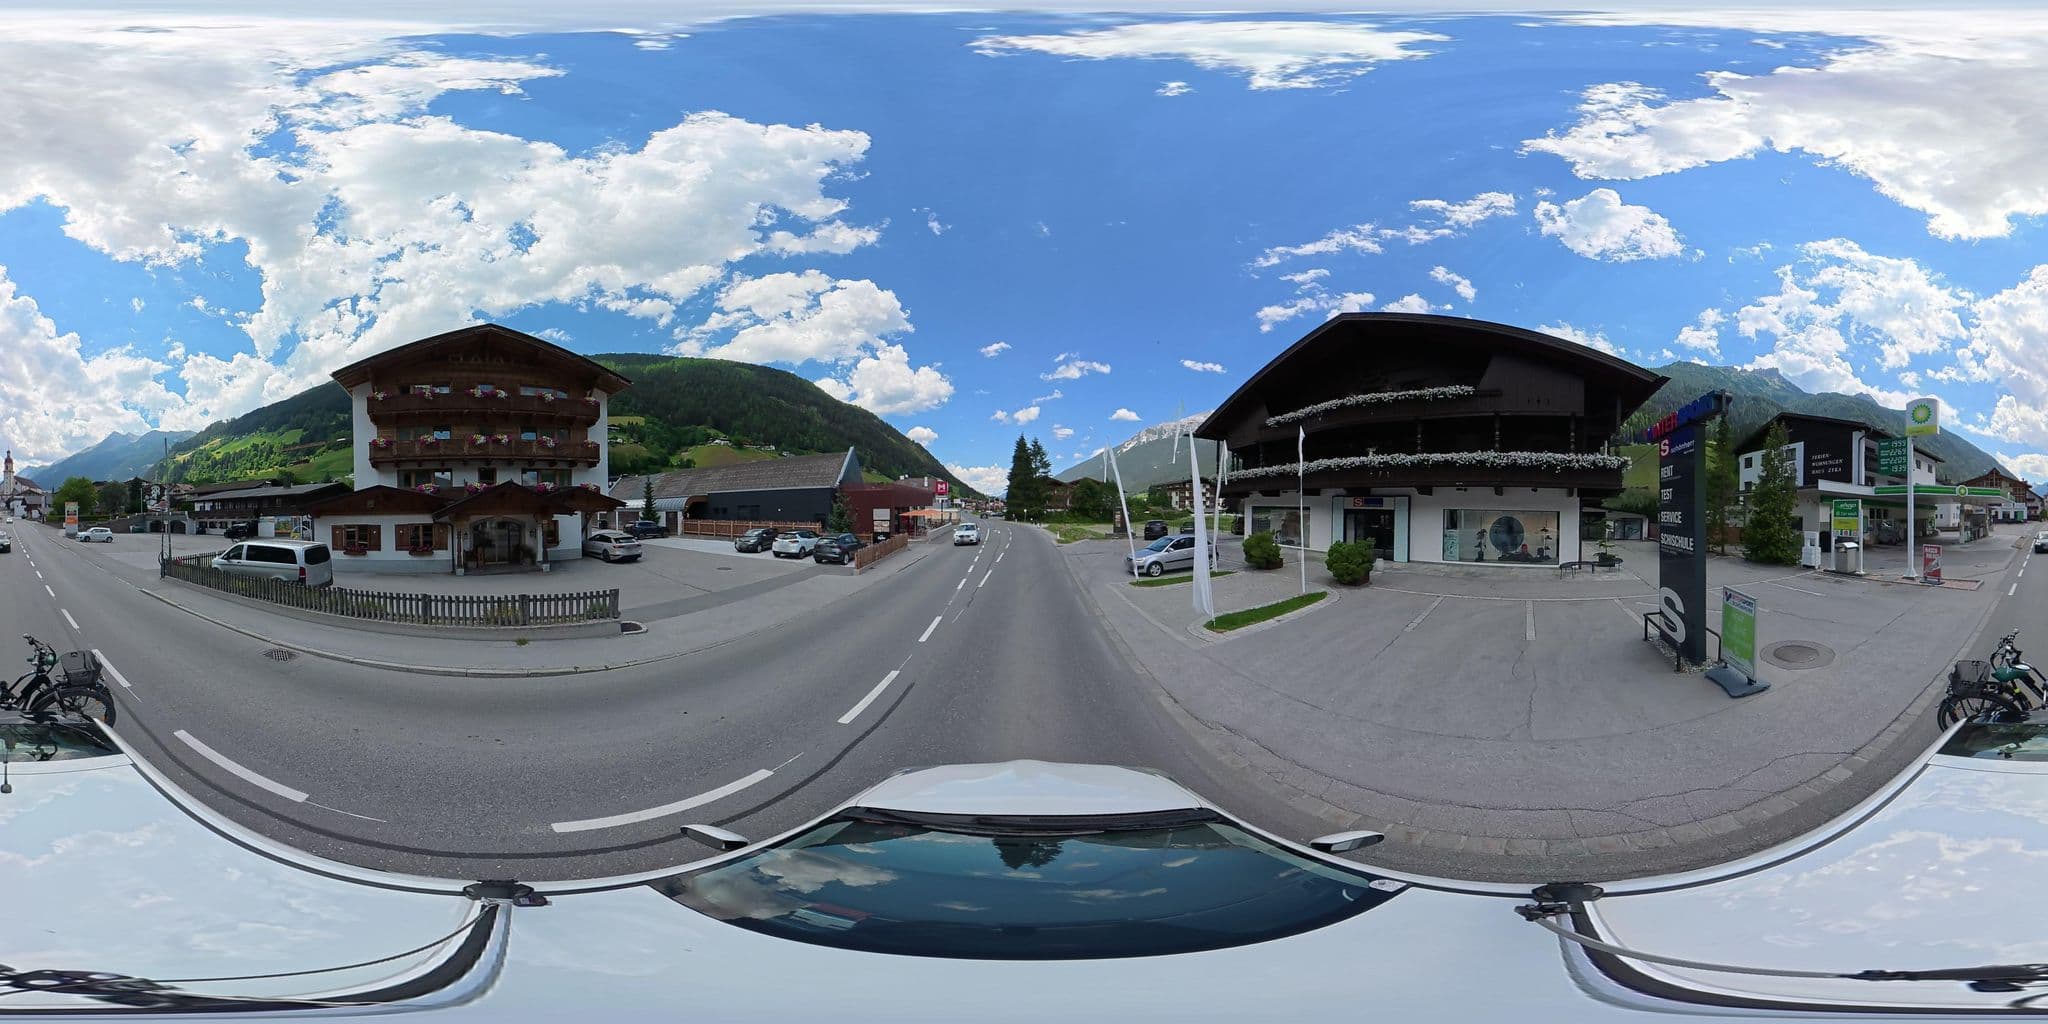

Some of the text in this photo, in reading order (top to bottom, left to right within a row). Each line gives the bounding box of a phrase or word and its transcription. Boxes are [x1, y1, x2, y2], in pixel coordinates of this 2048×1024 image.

[1660, 439, 1670, 457] S
[1660, 465, 1674, 478] RENT
[1661, 488, 1673, 500] TEST
[1661, 511, 1682, 524] SERVICE
[1660, 533, 1694, 551] SCHISCHULE
[1660, 586, 1686, 643] S
